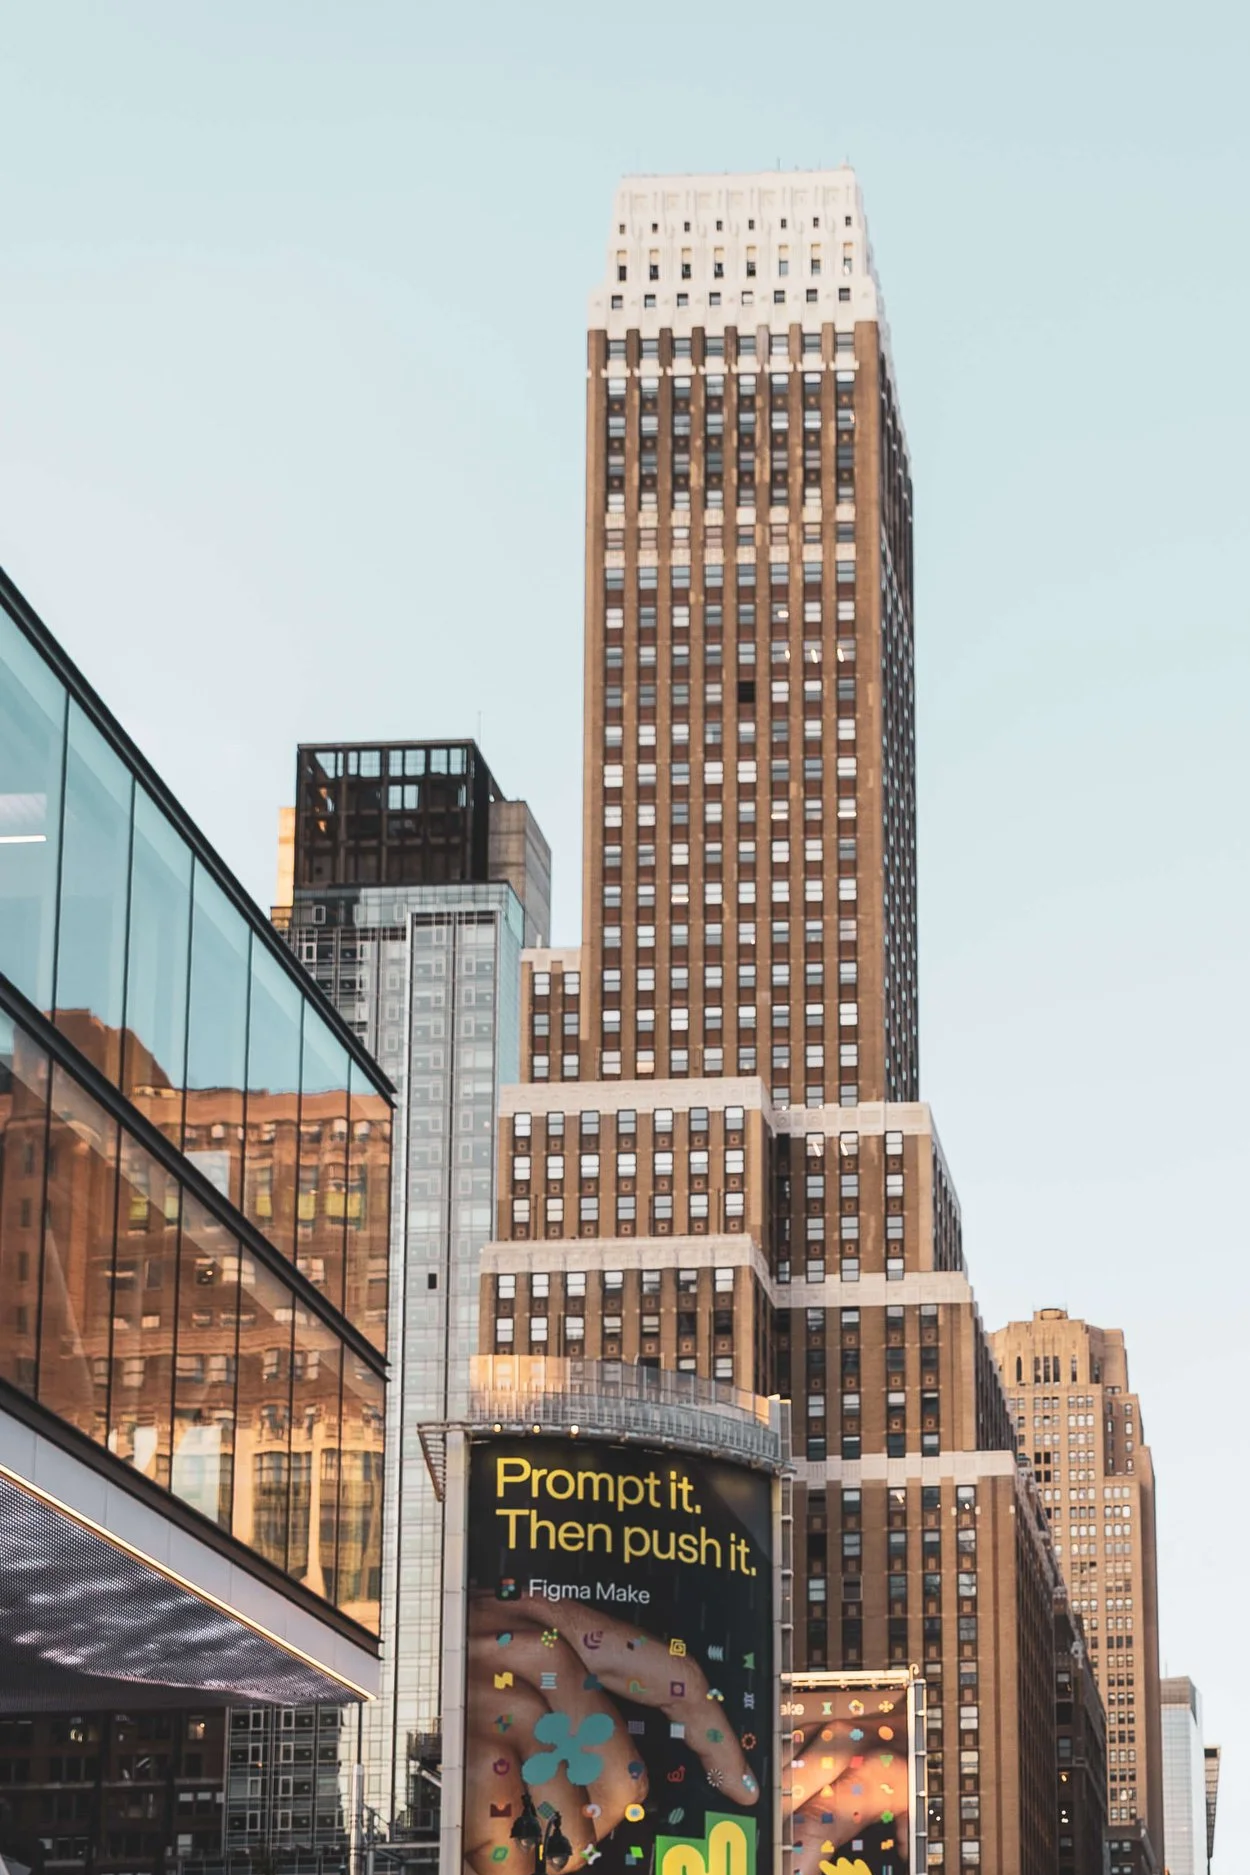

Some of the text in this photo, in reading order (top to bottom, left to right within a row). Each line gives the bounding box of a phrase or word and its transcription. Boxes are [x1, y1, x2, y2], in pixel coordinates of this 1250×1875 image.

[495, 1456, 702, 1514] Prompt it.
[495, 1508, 757, 1577] Then push it.
[528, 1578, 651, 1604] Figma Make
[779, 1700, 805, 1716] ake
